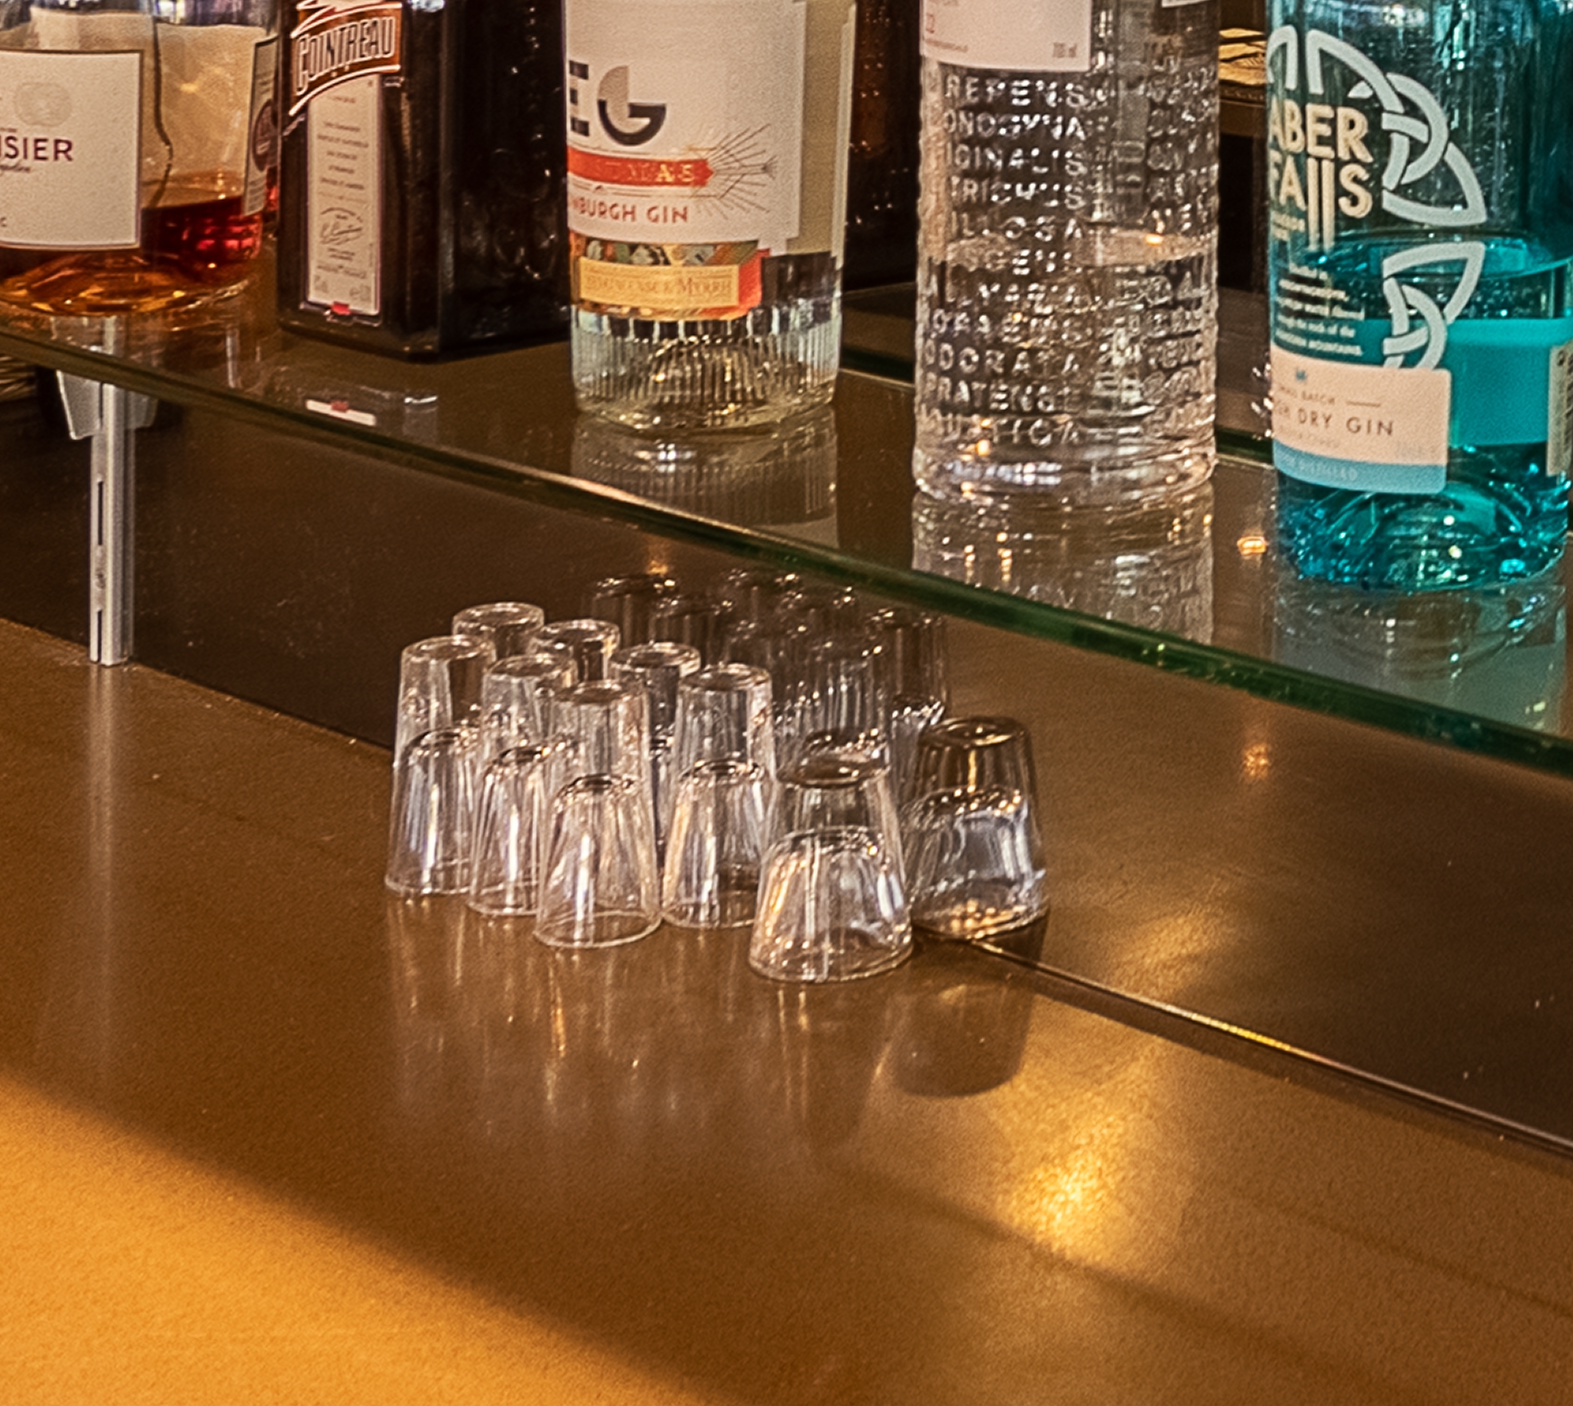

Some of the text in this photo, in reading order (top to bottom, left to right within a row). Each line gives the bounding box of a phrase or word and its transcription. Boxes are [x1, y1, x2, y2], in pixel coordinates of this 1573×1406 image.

[295, 16, 397, 97] COINTREAU
[1268, 95, 1374, 164] ABER
[646, 205, 688, 224] GIN
[1297, 406, 1394, 437] DRY GIN
